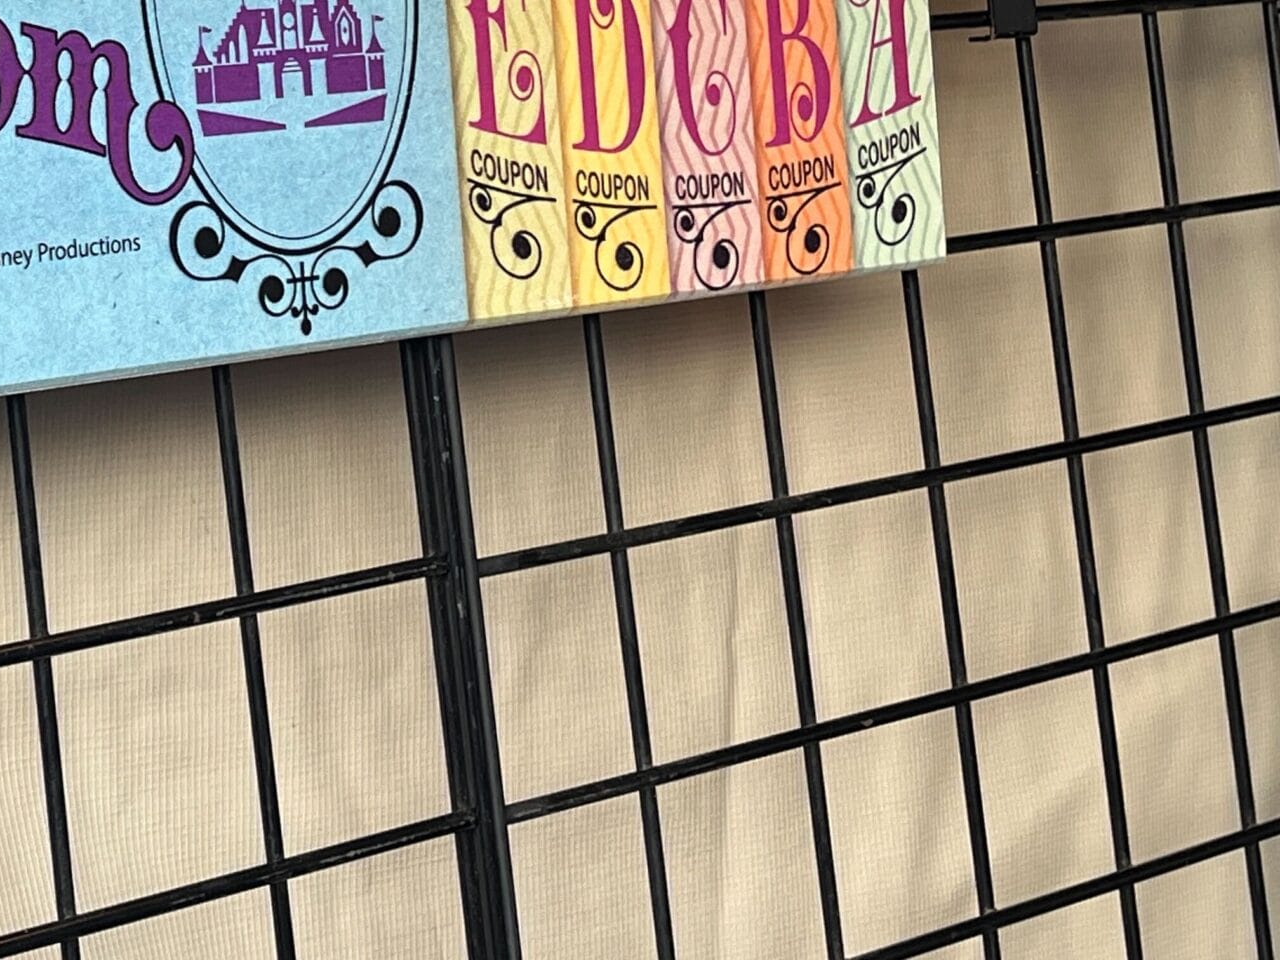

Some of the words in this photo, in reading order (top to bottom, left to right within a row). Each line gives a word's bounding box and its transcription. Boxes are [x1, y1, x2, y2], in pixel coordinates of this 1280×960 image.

[857, 121, 922, 166] COUPON
[470, 149, 549, 193] COUPON
[575, 170, 650, 202] COUPON
[674, 171, 745, 202] COUPON
[768, 154, 835, 190] COUPON
[37, 235, 141, 262] Productions
